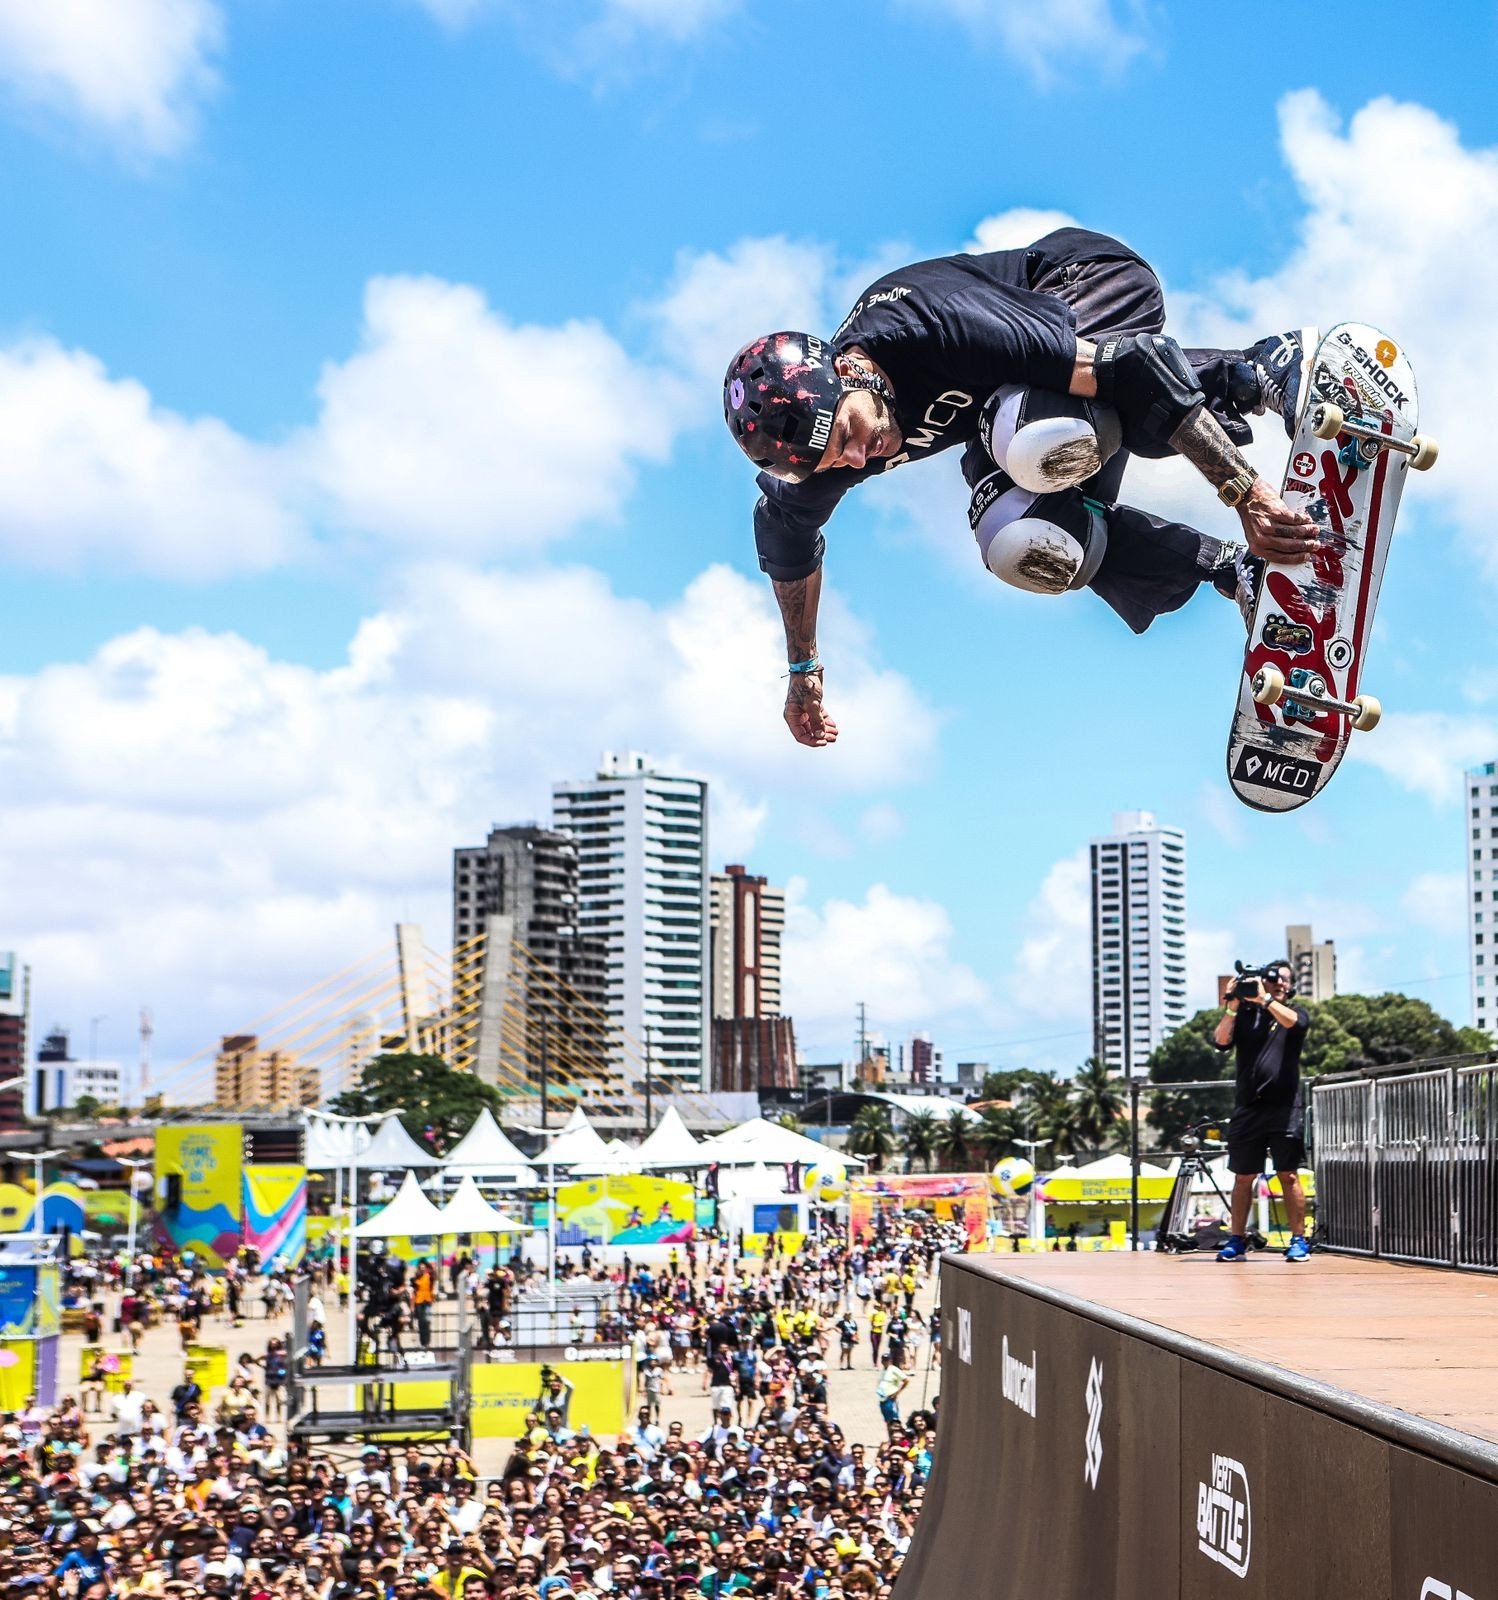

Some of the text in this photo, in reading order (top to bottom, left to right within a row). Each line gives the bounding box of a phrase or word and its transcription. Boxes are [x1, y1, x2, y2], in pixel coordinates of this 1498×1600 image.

[807, 336, 823, 360] MCD
[1336, 332, 1409, 411] G-SHOCK
[905, 390, 974, 449] MCD
[1262, 760, 1310, 788] MCD
[1196, 1481, 1245, 1562] BATTLE
